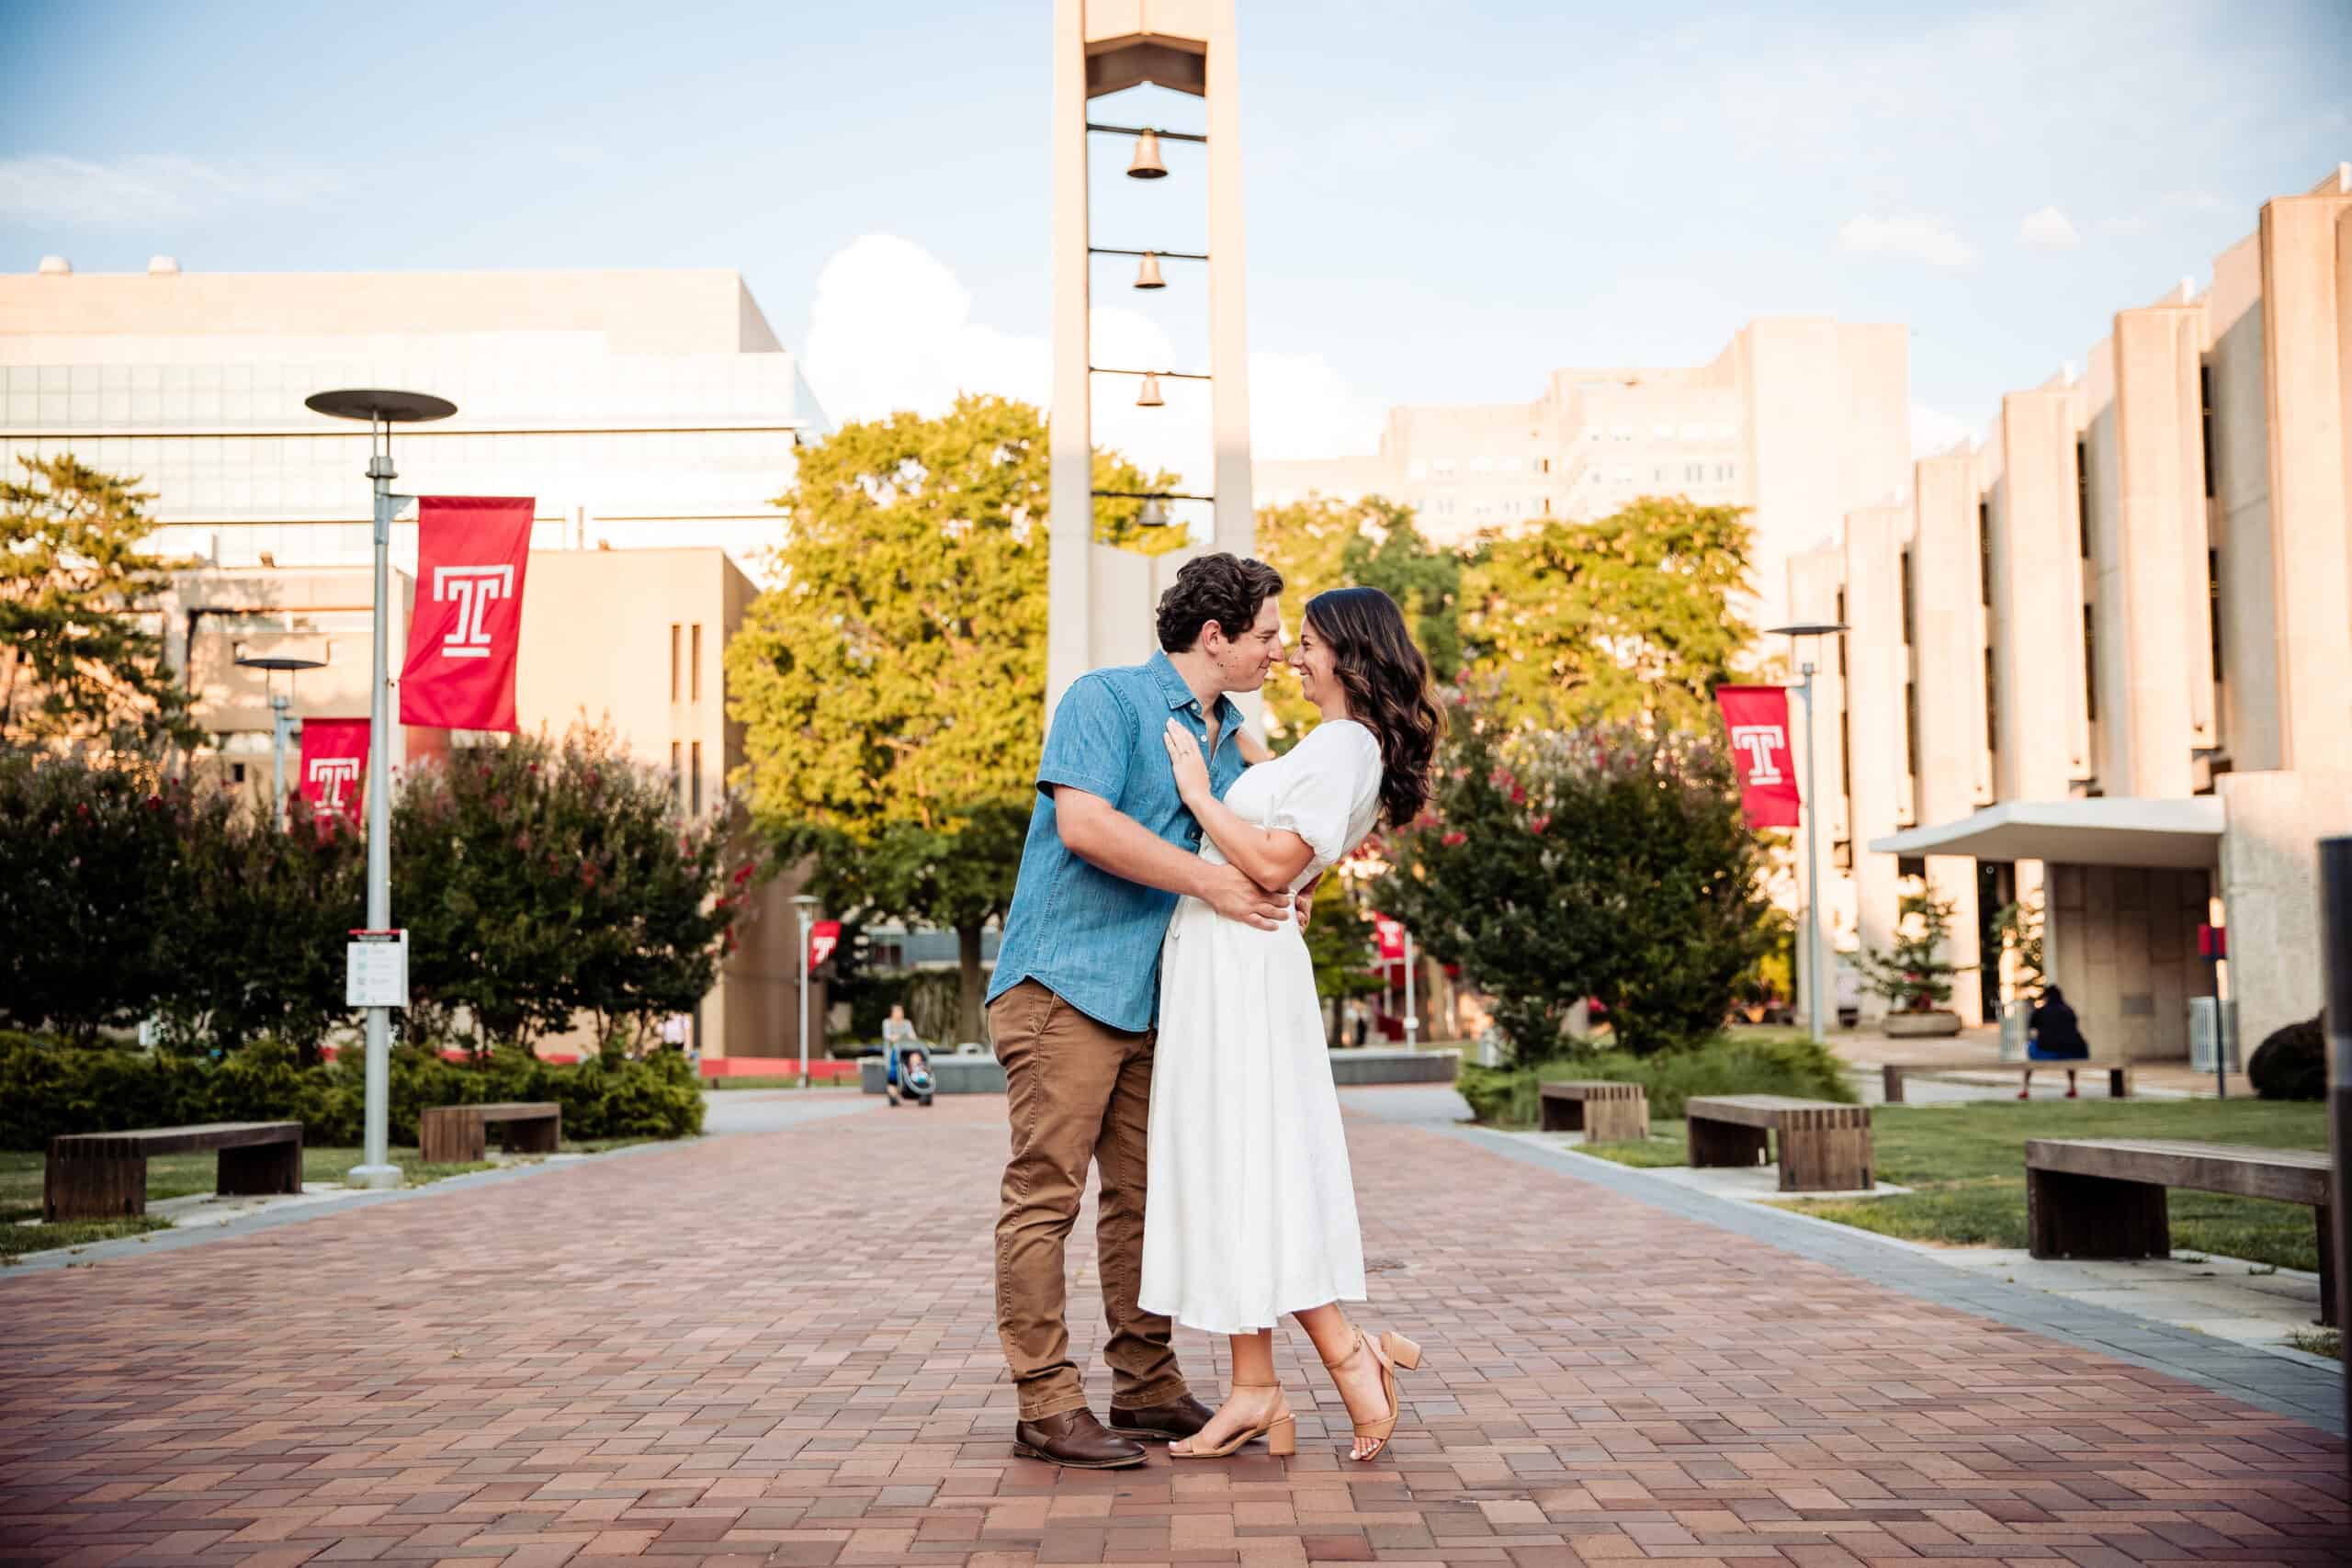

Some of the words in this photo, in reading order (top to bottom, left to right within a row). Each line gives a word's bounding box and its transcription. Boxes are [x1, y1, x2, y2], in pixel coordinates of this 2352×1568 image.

[433, 564, 514, 658] T
[1731, 725, 1785, 785] T
[310, 757, 360, 816] T
